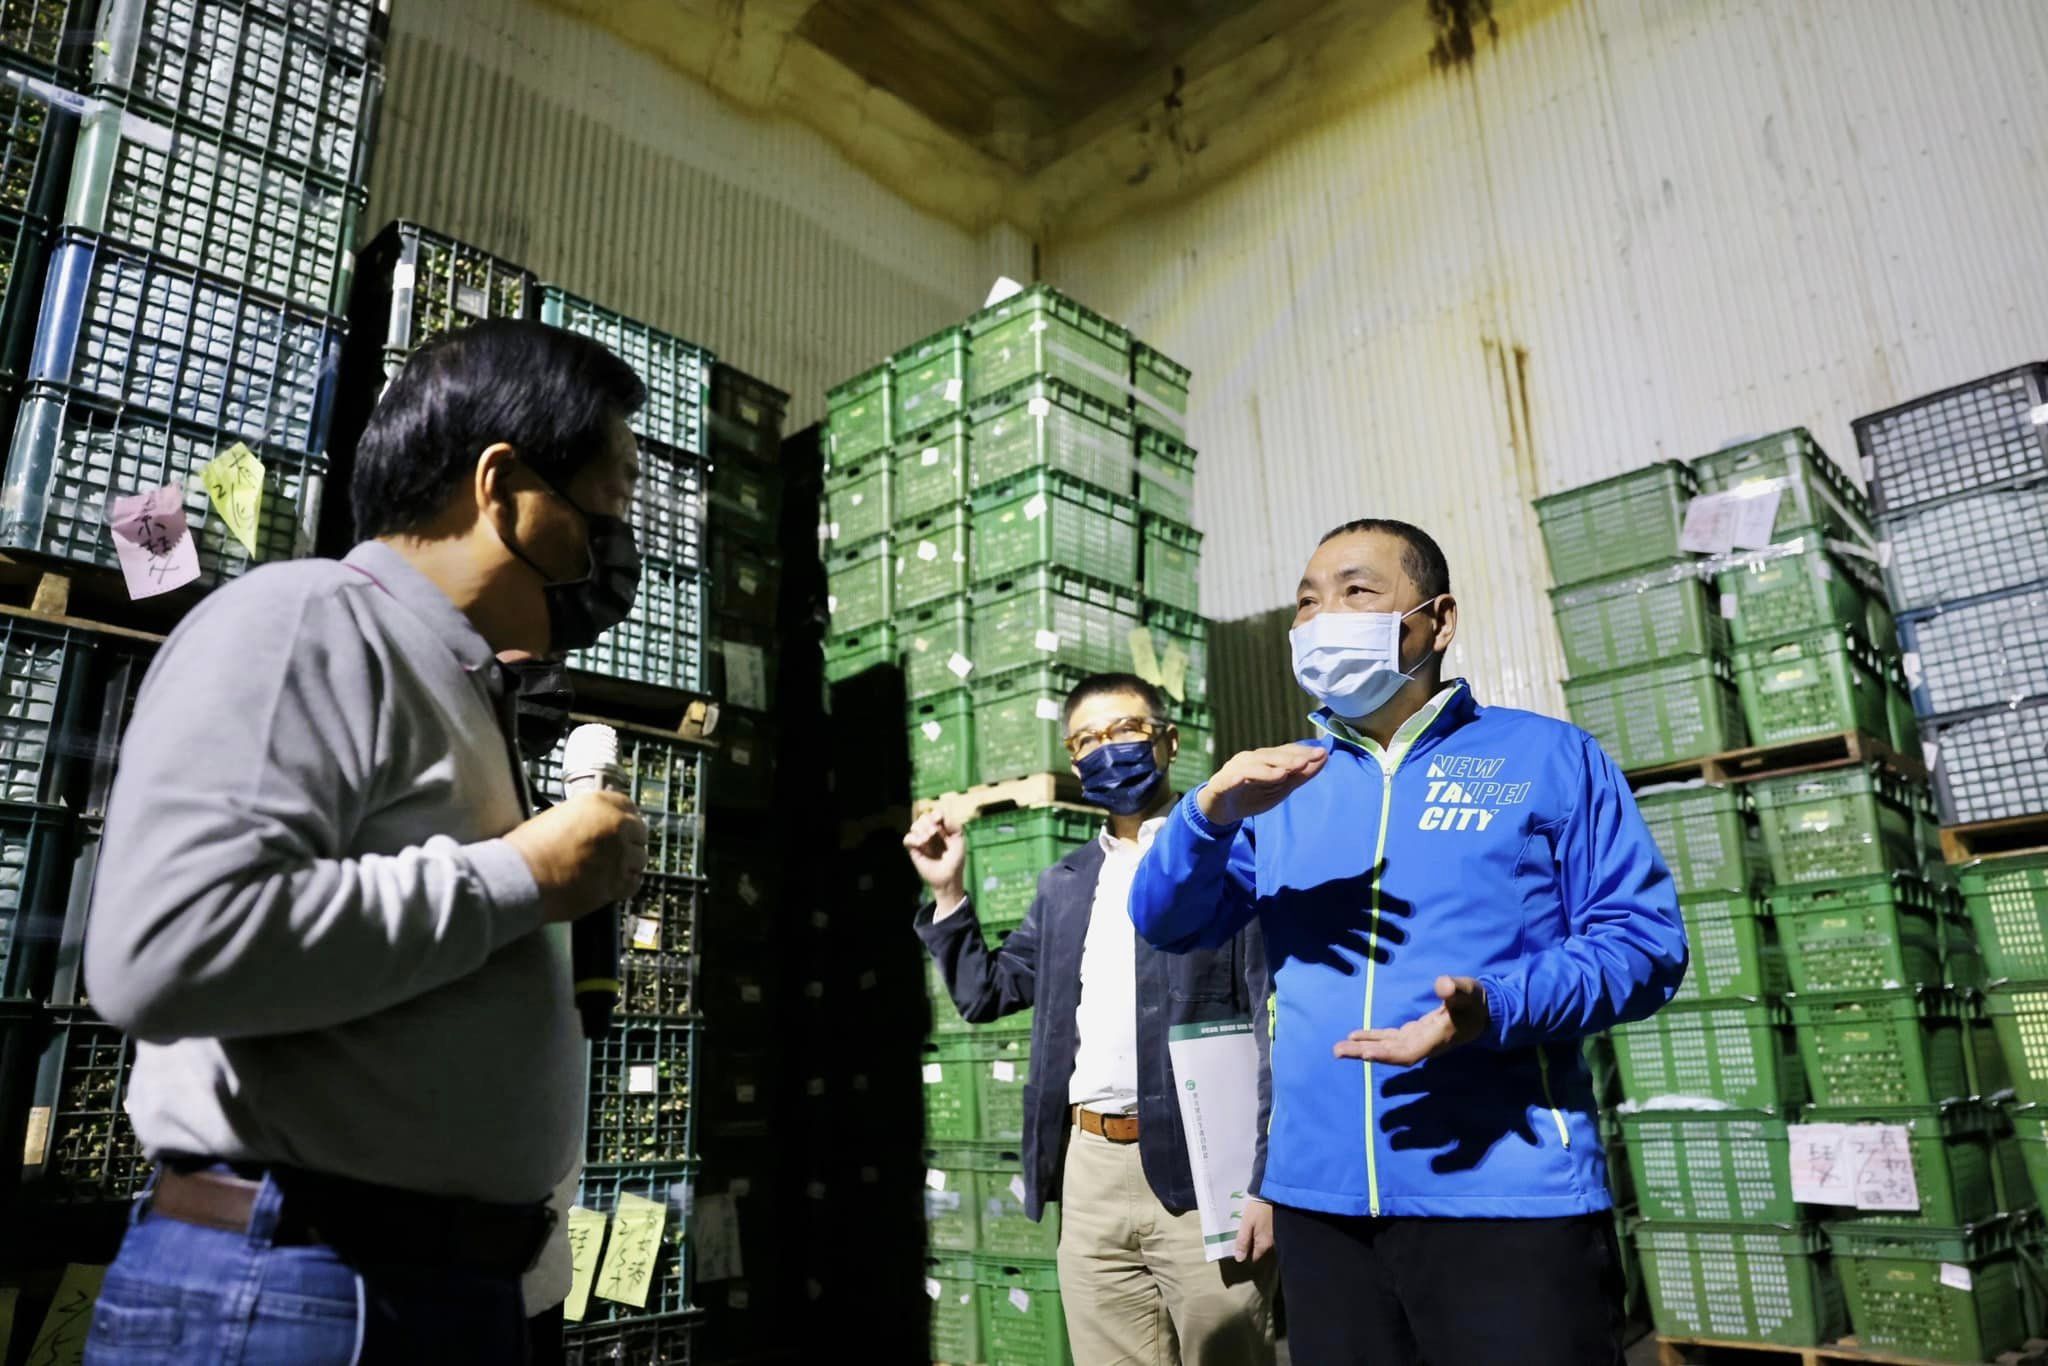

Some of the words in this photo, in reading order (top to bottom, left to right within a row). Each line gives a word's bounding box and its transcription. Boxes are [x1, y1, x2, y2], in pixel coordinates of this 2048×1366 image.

[1426, 754, 1506, 779] NEW
[1424, 781, 1531, 805] TAIPEI
[1418, 806, 1500, 831] CITY
